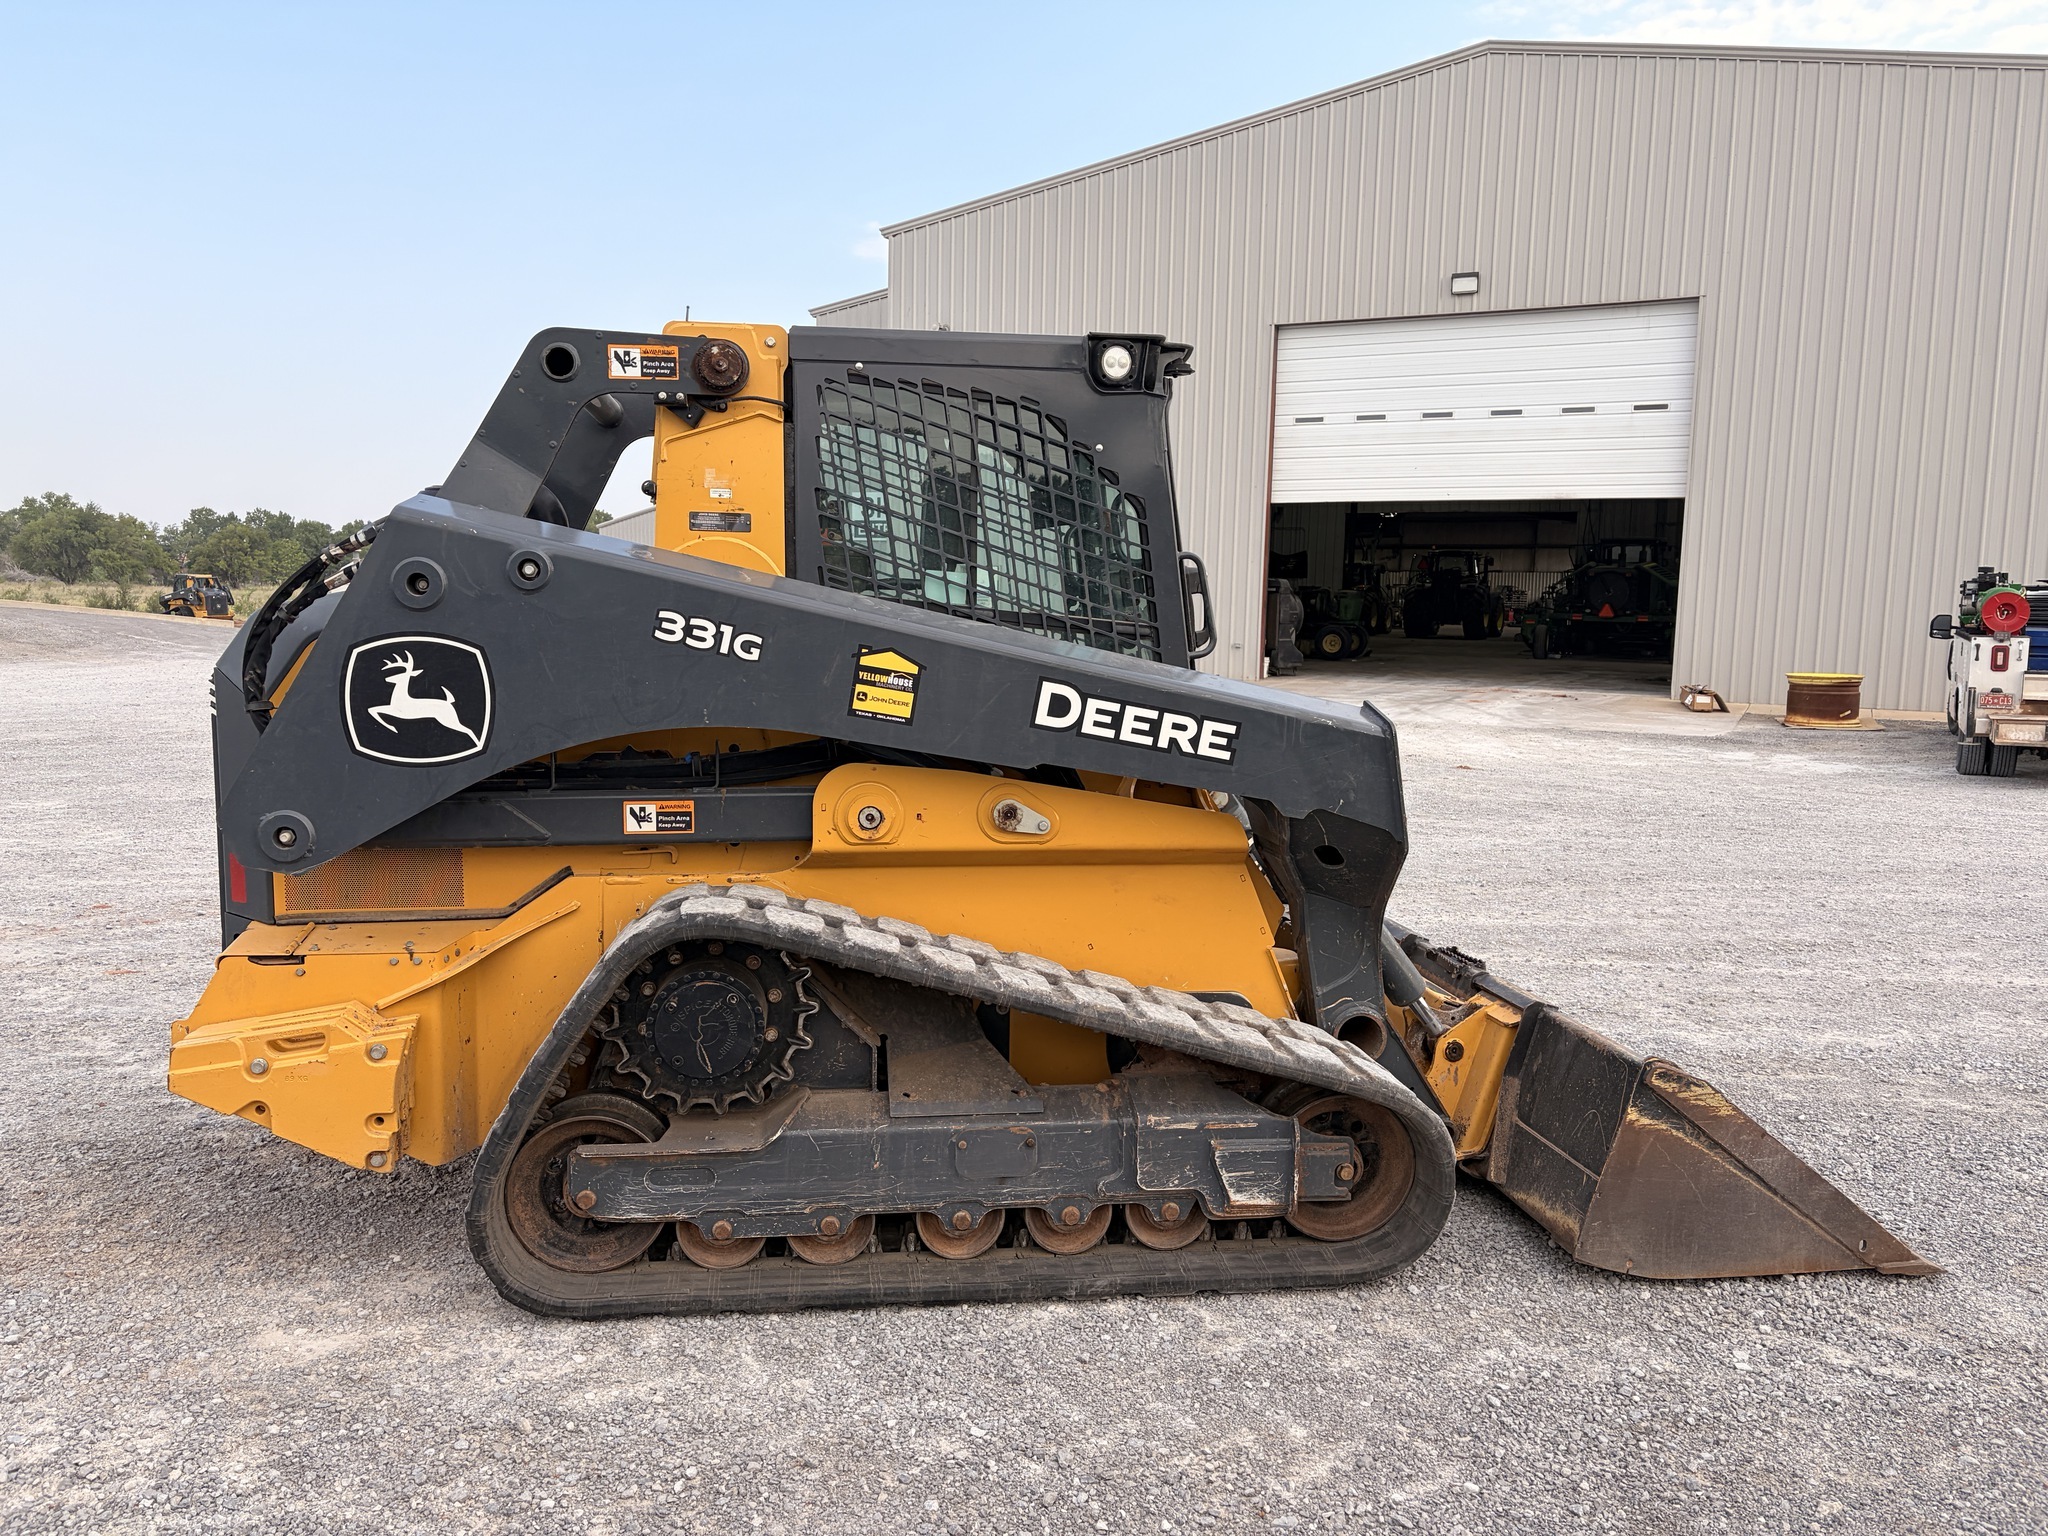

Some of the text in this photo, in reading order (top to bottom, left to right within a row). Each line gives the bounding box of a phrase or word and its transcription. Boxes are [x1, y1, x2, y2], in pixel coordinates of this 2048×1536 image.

[654, 610, 763, 661] 331G
[858, 671, 914, 688] YELLOWHOUSE
[875, 682, 904, 691] MACHINERY
[869, 695, 910, 707] JOHN DEERE
[876, 714, 906, 723] OKLAHOMA
[1034, 680, 1238, 761] DEERE
